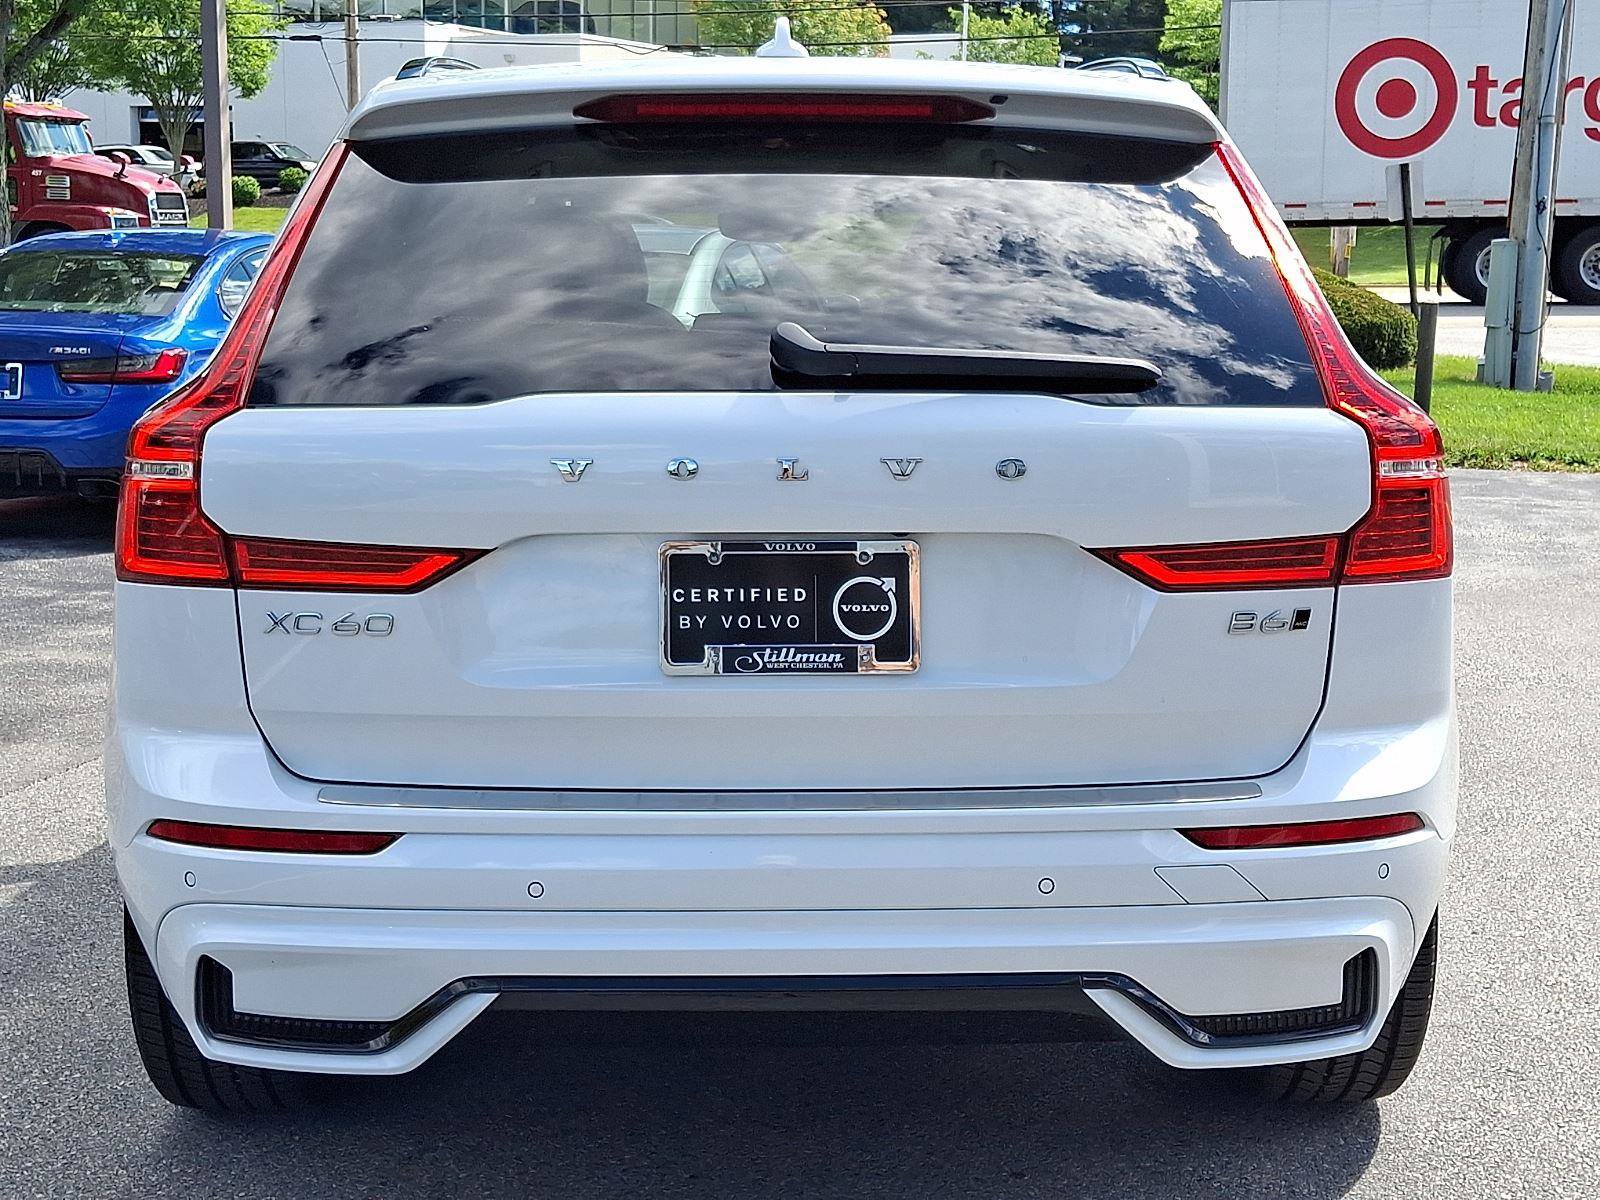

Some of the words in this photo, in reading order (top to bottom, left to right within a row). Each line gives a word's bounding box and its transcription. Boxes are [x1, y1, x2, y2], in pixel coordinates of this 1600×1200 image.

[550, 457, 1027, 482] VOLVO
[763, 542, 816, 551] VOLVO
[672, 587, 807, 603] CERTIFIED
[840, 603, 890, 613] VOLVO
[679, 615, 707, 629] BY
[721, 614, 800, 629] VOLVO
[1228, 609, 1289, 635] B6
[734, 647, 845, 672] Stillman
[792, 662, 832, 670] CHESTER,
